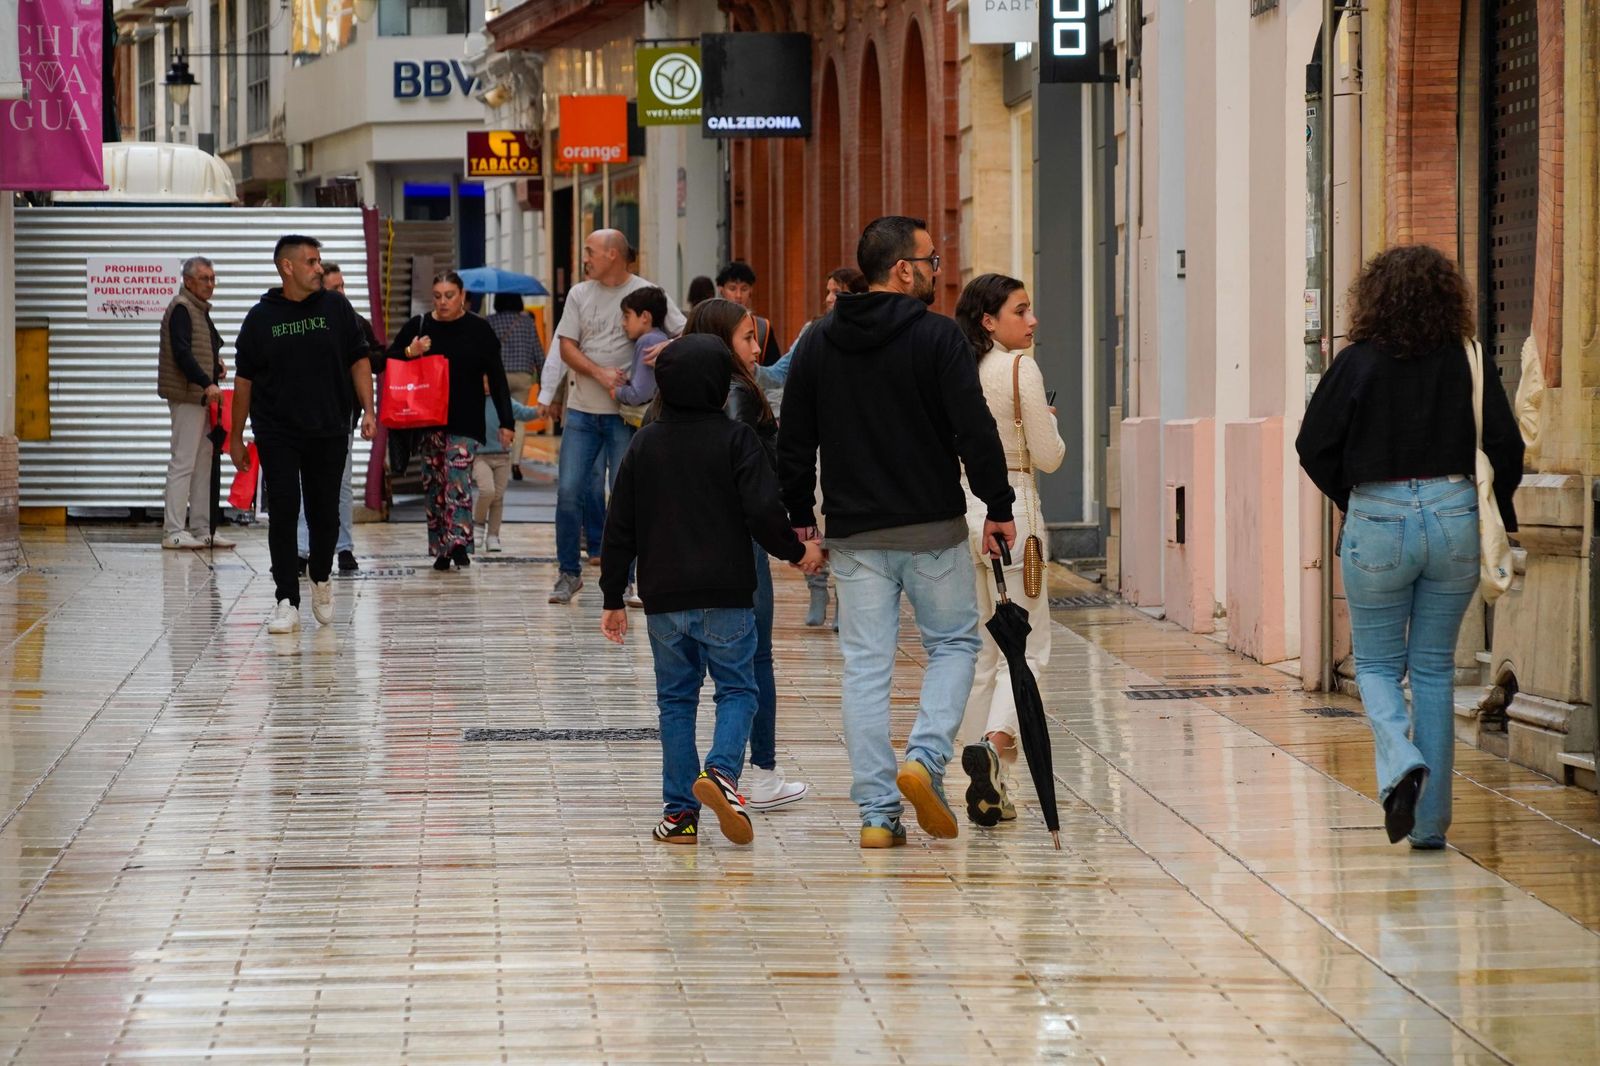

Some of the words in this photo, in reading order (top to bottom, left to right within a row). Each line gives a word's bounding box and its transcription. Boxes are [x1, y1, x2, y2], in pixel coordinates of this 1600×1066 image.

[985, 0, 1039, 11] PARF
[393, 59, 482, 97] BBV
[9, 99, 90, 131] GUA
[707, 116, 801, 130] CALZEDONIA
[563, 146, 621, 162] orange
[470, 157, 539, 171] TABACOS
[105, 265, 162, 273] PROHIBIDO
[91, 276, 120, 284] FIJAR
[123, 276, 177, 284] CARTELES
[94, 287, 173, 295] PUBLICITARIOS
[272, 317, 327, 337] BEETLEJUICE
